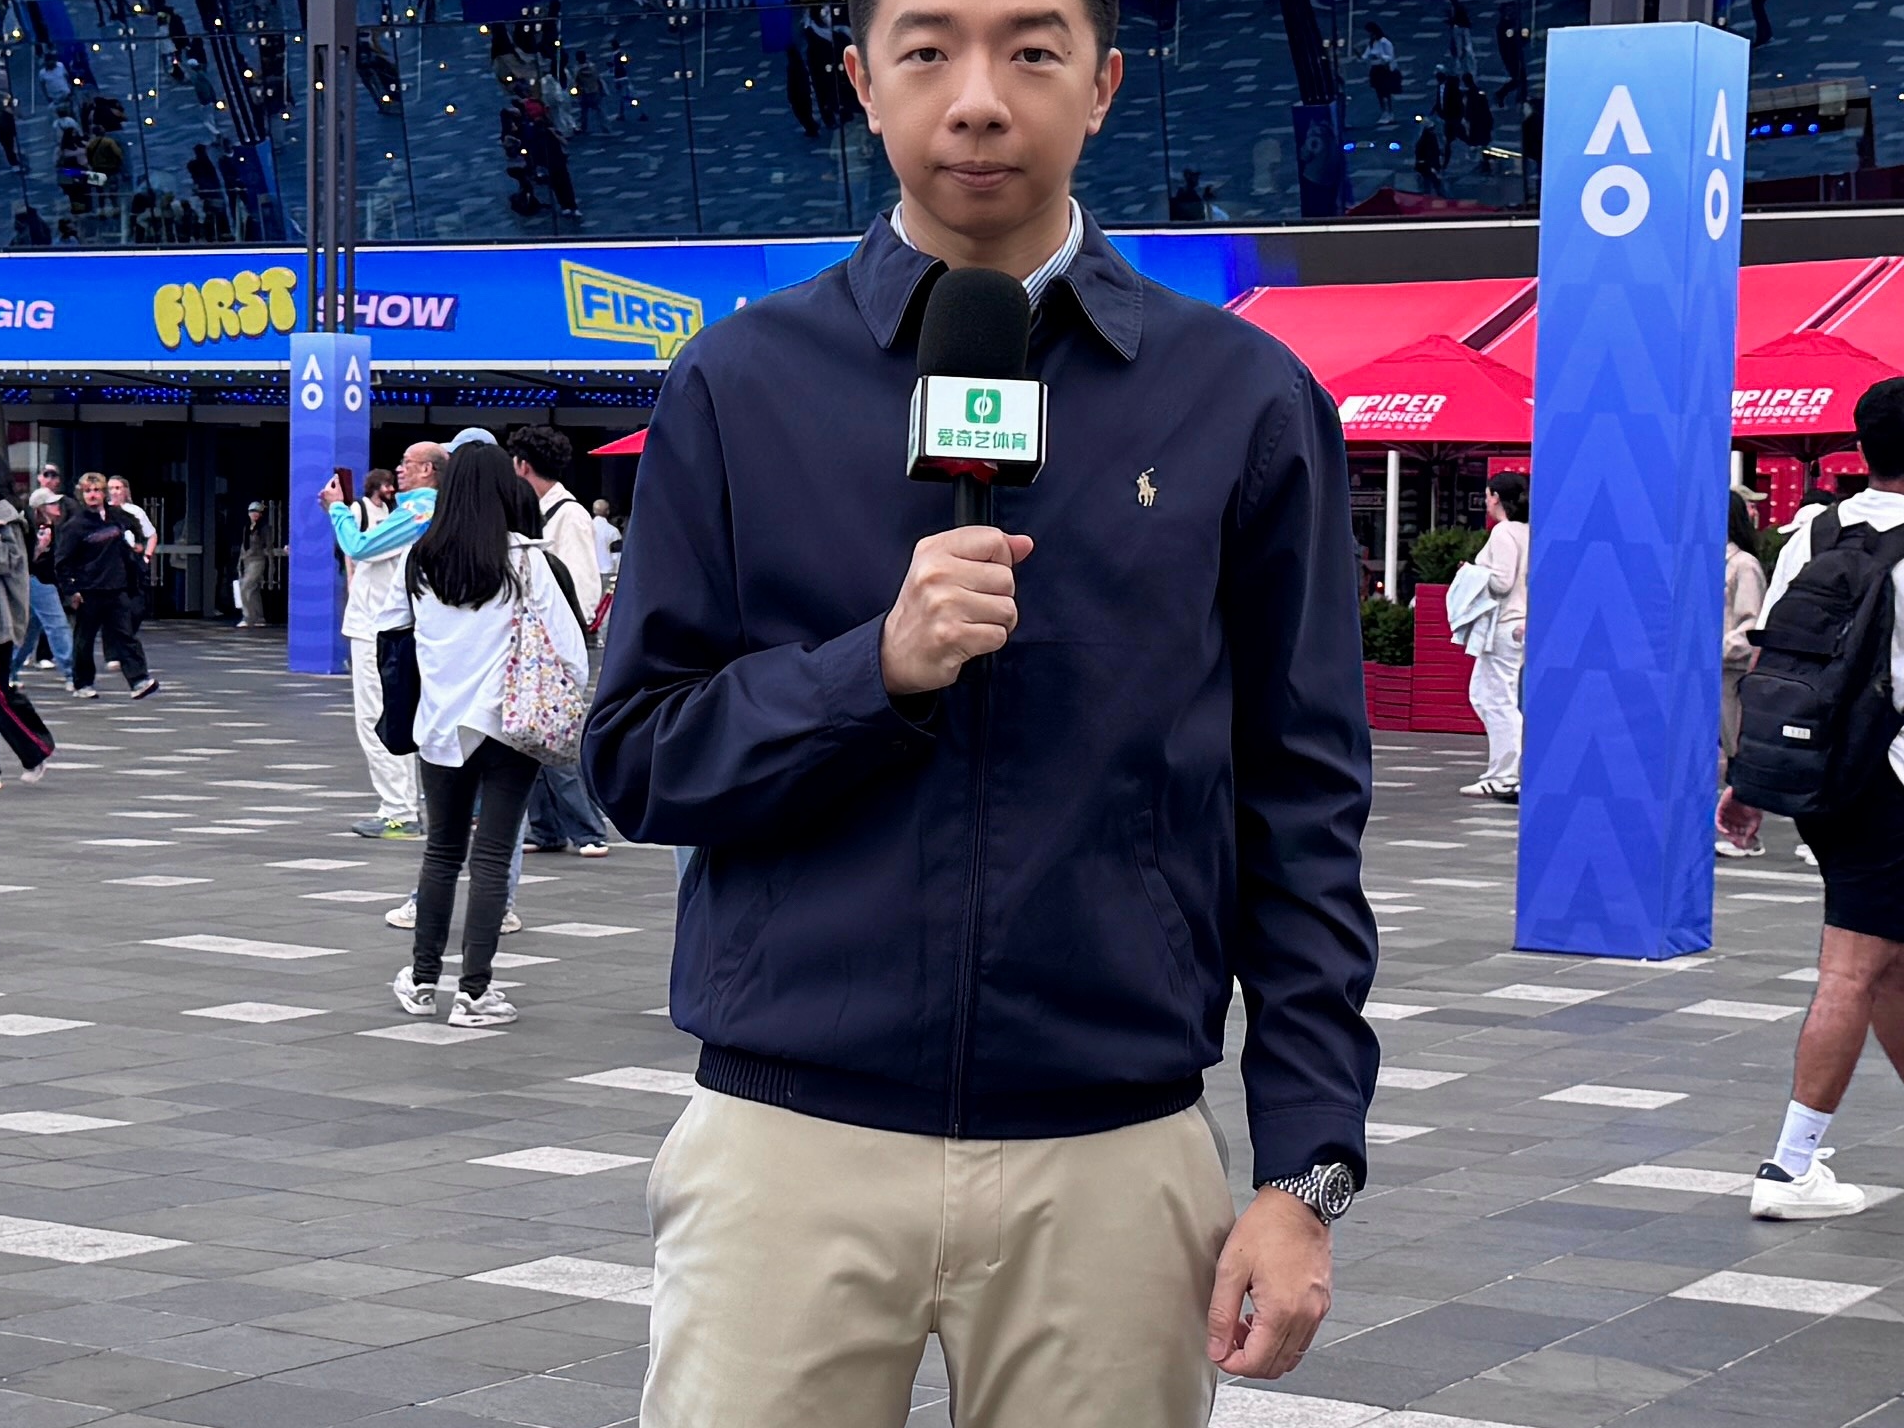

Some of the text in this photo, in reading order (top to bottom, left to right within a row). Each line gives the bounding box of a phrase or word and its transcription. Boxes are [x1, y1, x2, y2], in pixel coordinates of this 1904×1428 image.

[154, 267, 455, 349] FIRST SHOW
[581, 284, 693, 335] FIRST
[1360, 393, 1446, 412] PIPER
[1738, 388, 1833, 407] PIPER
[937, 428, 1027, 451] 爱奇艺体育
